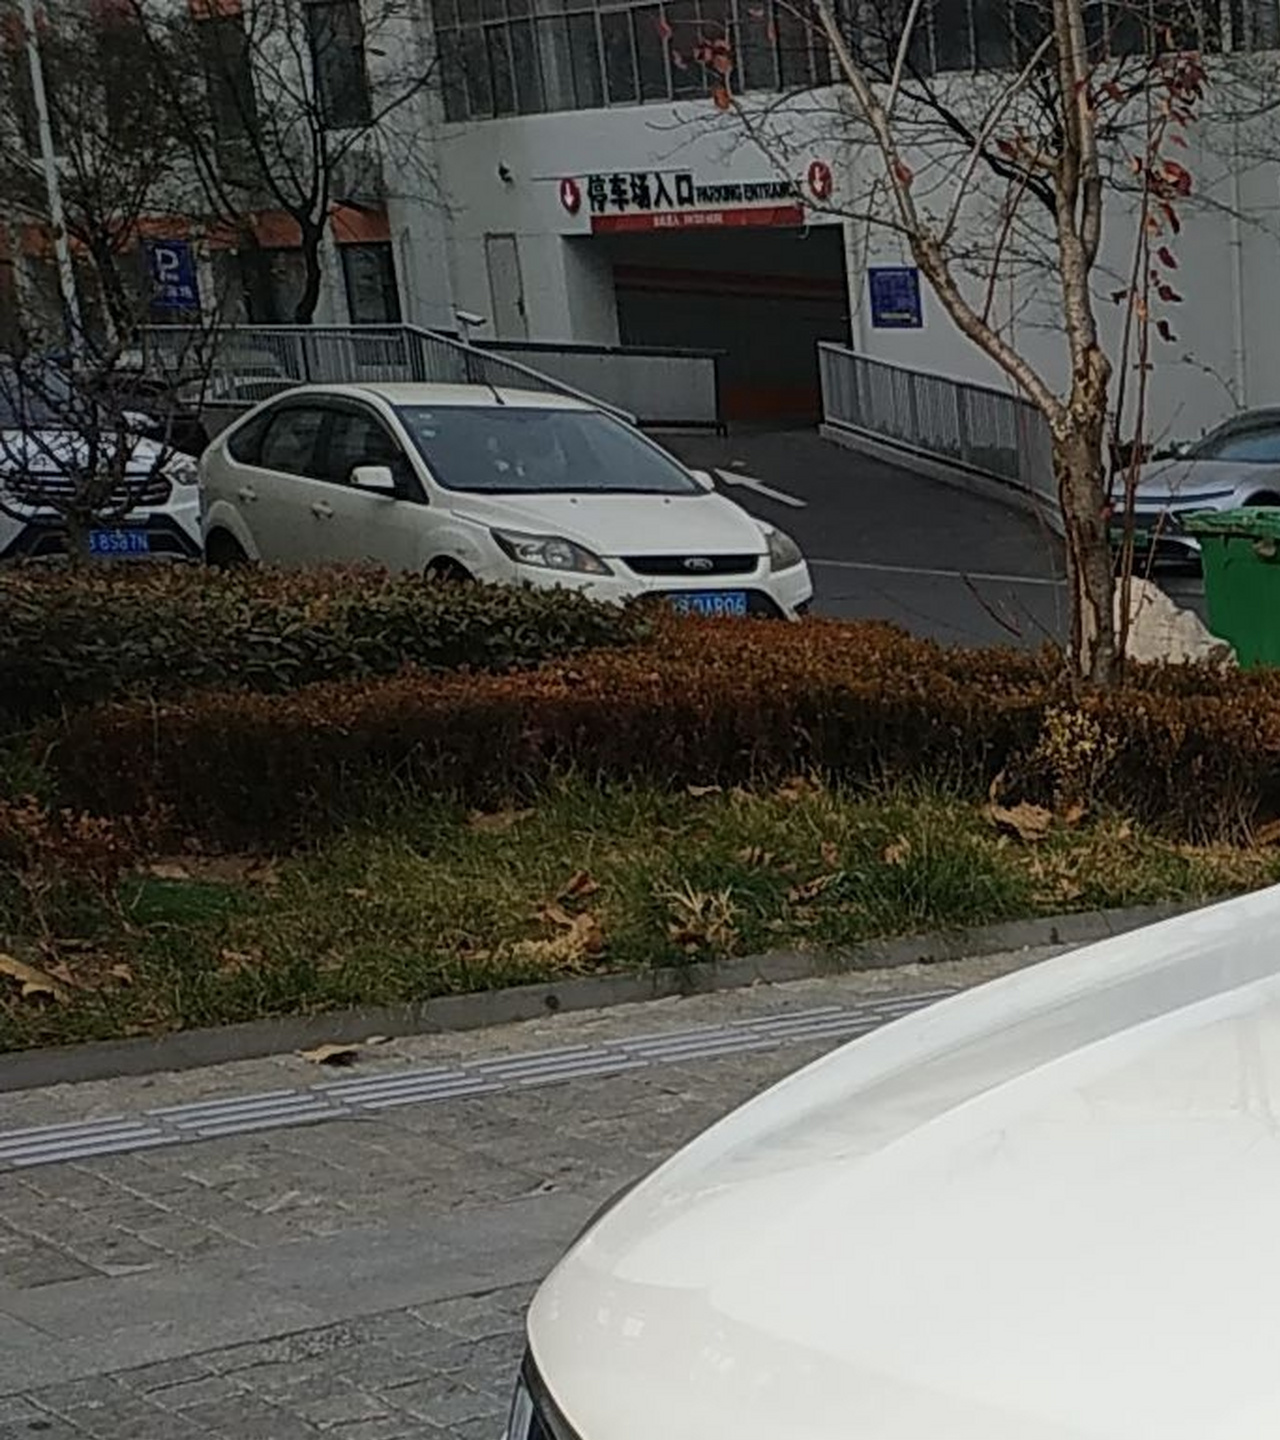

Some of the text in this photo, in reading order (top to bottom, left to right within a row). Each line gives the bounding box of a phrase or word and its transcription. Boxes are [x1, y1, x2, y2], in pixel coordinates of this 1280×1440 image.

[586, 171, 695, 213] 停车场入口
[695, 184, 742, 205] PARKING
